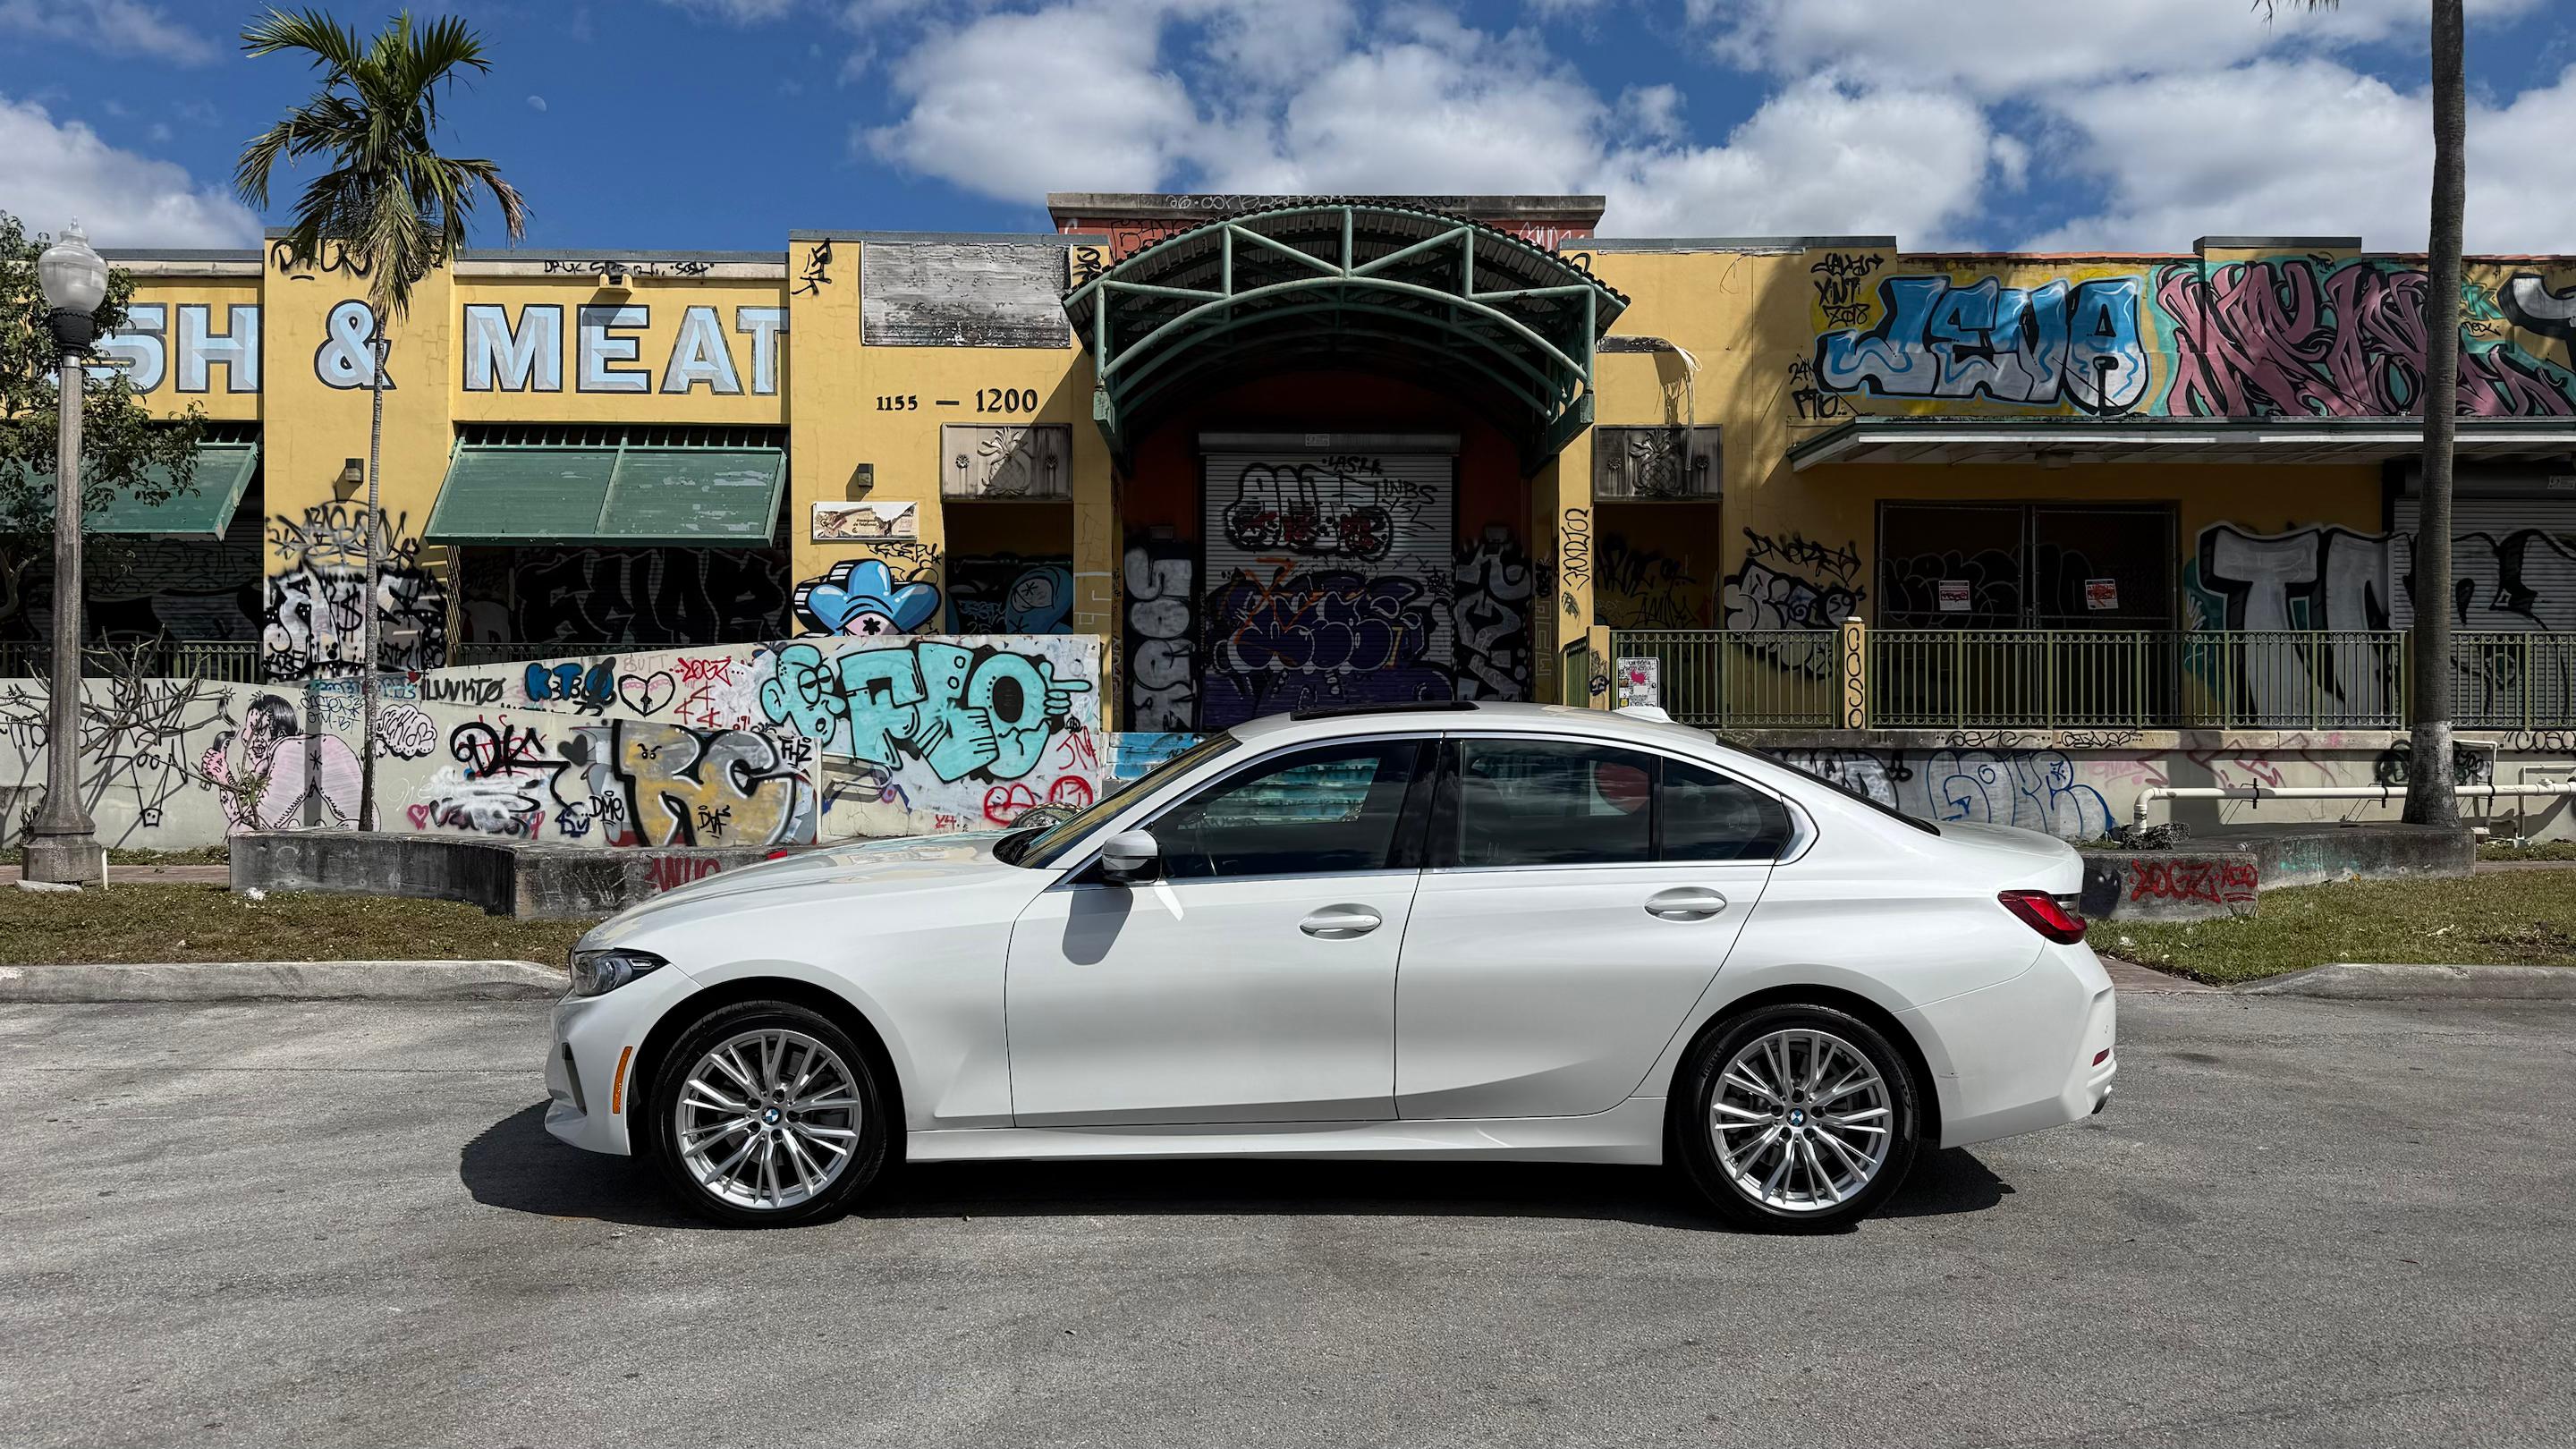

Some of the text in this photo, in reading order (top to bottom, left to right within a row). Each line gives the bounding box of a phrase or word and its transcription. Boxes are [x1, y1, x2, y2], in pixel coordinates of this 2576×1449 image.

[314, 299, 397, 391] &
[462, 302, 790, 395] MEAT
[876, 394, 919, 411] 1155
[975, 388, 1038, 413] 1200
